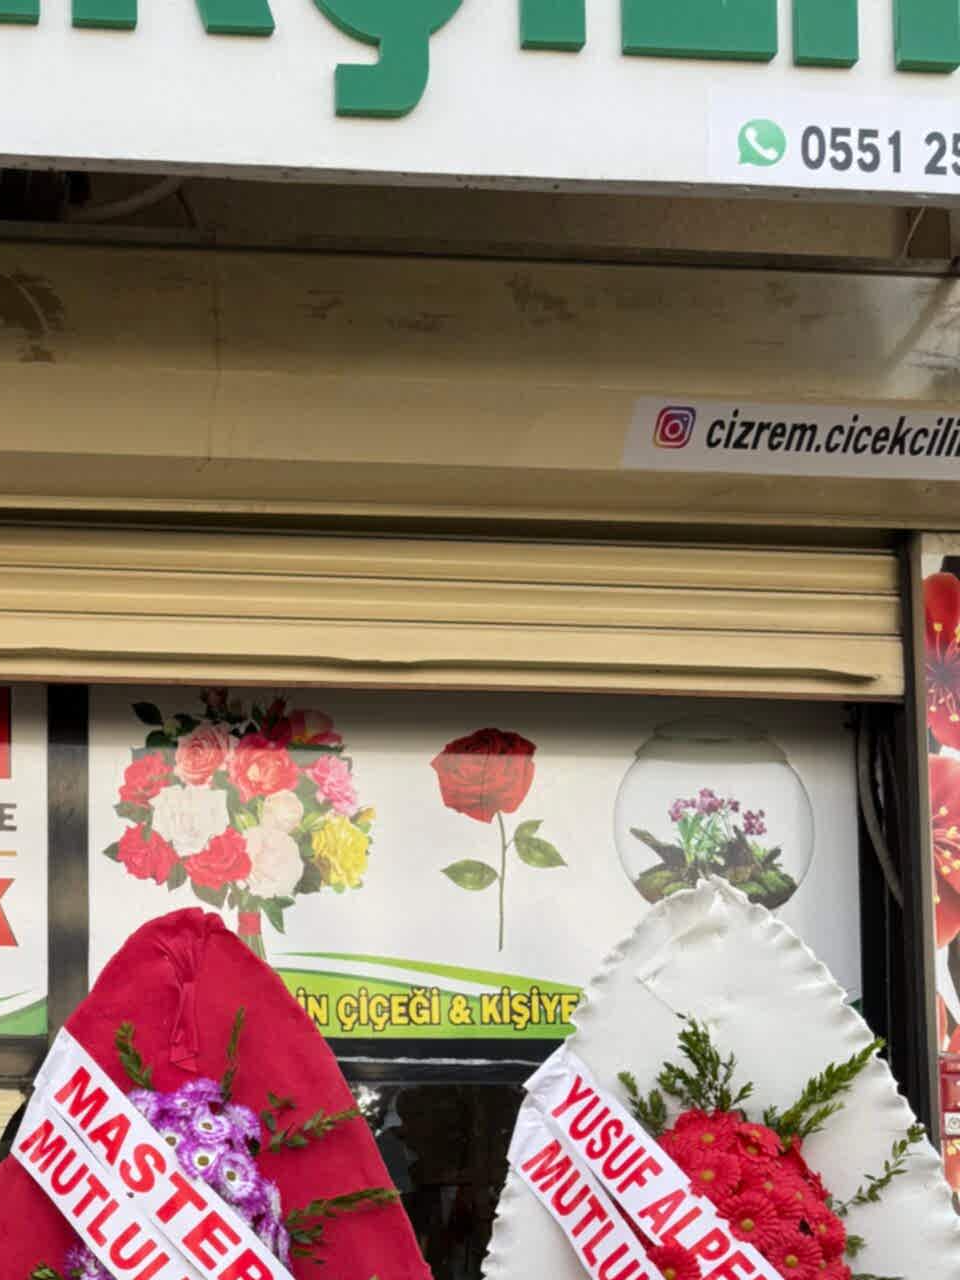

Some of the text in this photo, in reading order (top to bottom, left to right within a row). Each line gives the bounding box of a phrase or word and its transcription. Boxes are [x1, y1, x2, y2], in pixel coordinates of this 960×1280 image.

[801, 126, 901, 174] 0551
[706, 409, 960, 457] cizrem.cicekcili
[337, 985, 440, 1032] ÇİÇEĞİ
[448, 994, 474, 1024] &
[551, 1075, 663, 1194] YUSUF
